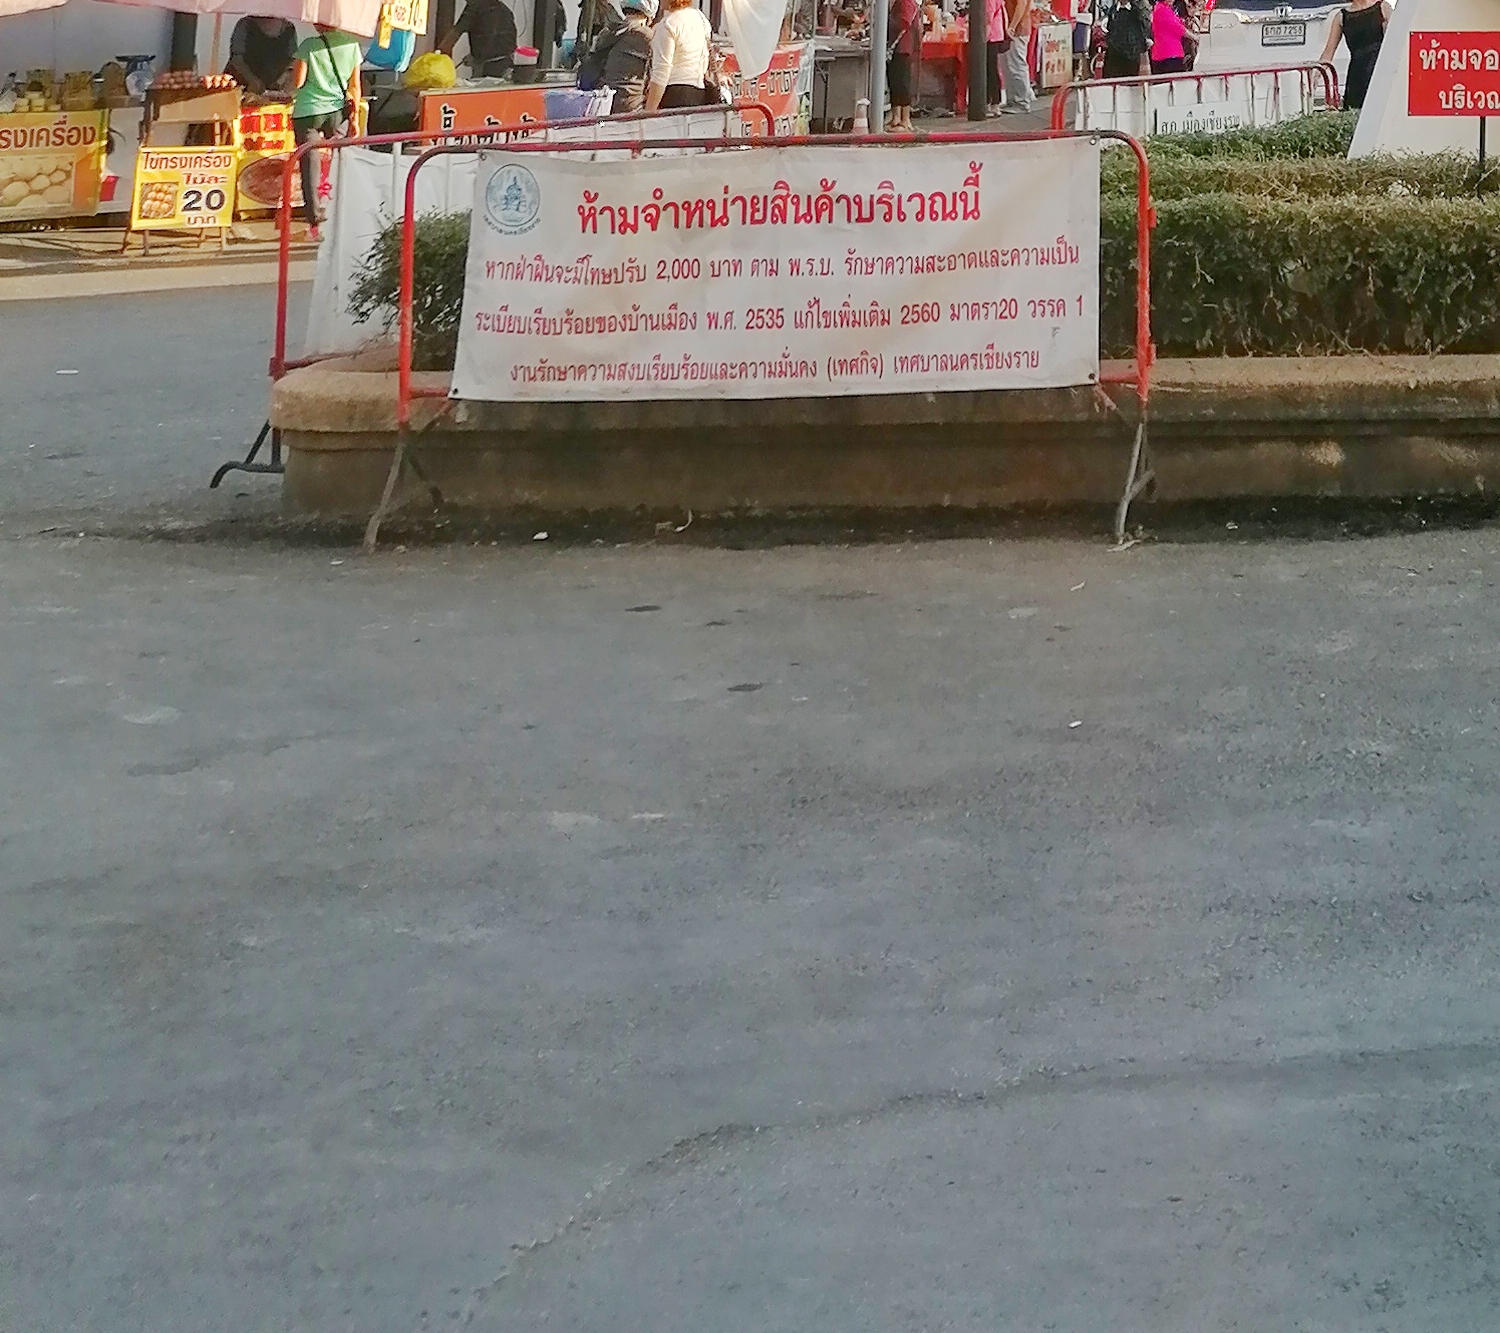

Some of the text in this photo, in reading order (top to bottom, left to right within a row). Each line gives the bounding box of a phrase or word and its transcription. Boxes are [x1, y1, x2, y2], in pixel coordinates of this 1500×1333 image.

[182, 189, 226, 212] 20
[577, 160, 982, 235] ห้ามจำหน่ายสินค้าบริเวณนี้
[656, 259, 701, 282] 2,000
[710, 258, 743, 278] บาท
[750, 257, 779, 278] ตาม
[788, 256, 834, 277] พ.ร.บ.
[844, 235, 1080, 276] รักษาความสะอาดและความเป็น
[474, 302, 698, 336] ระเบียบเรียบร้อยของบ้านเมือง
[706, 310, 737, 330] พ.ศ.
[745, 308, 785, 330] 2535
[793, 294, 891, 330] แก้ไขเพิ่มเติม
[900, 302, 941, 325] 2560
[1027, 298, 1067, 318] วรรค
[1076, 294, 1084, 317] 1
[510, 342, 1040, 384] งานรักษาความสงบเรียบร้อยและความมั่นคง (เทศกิจ) เทศบาลนครเชียงราย
